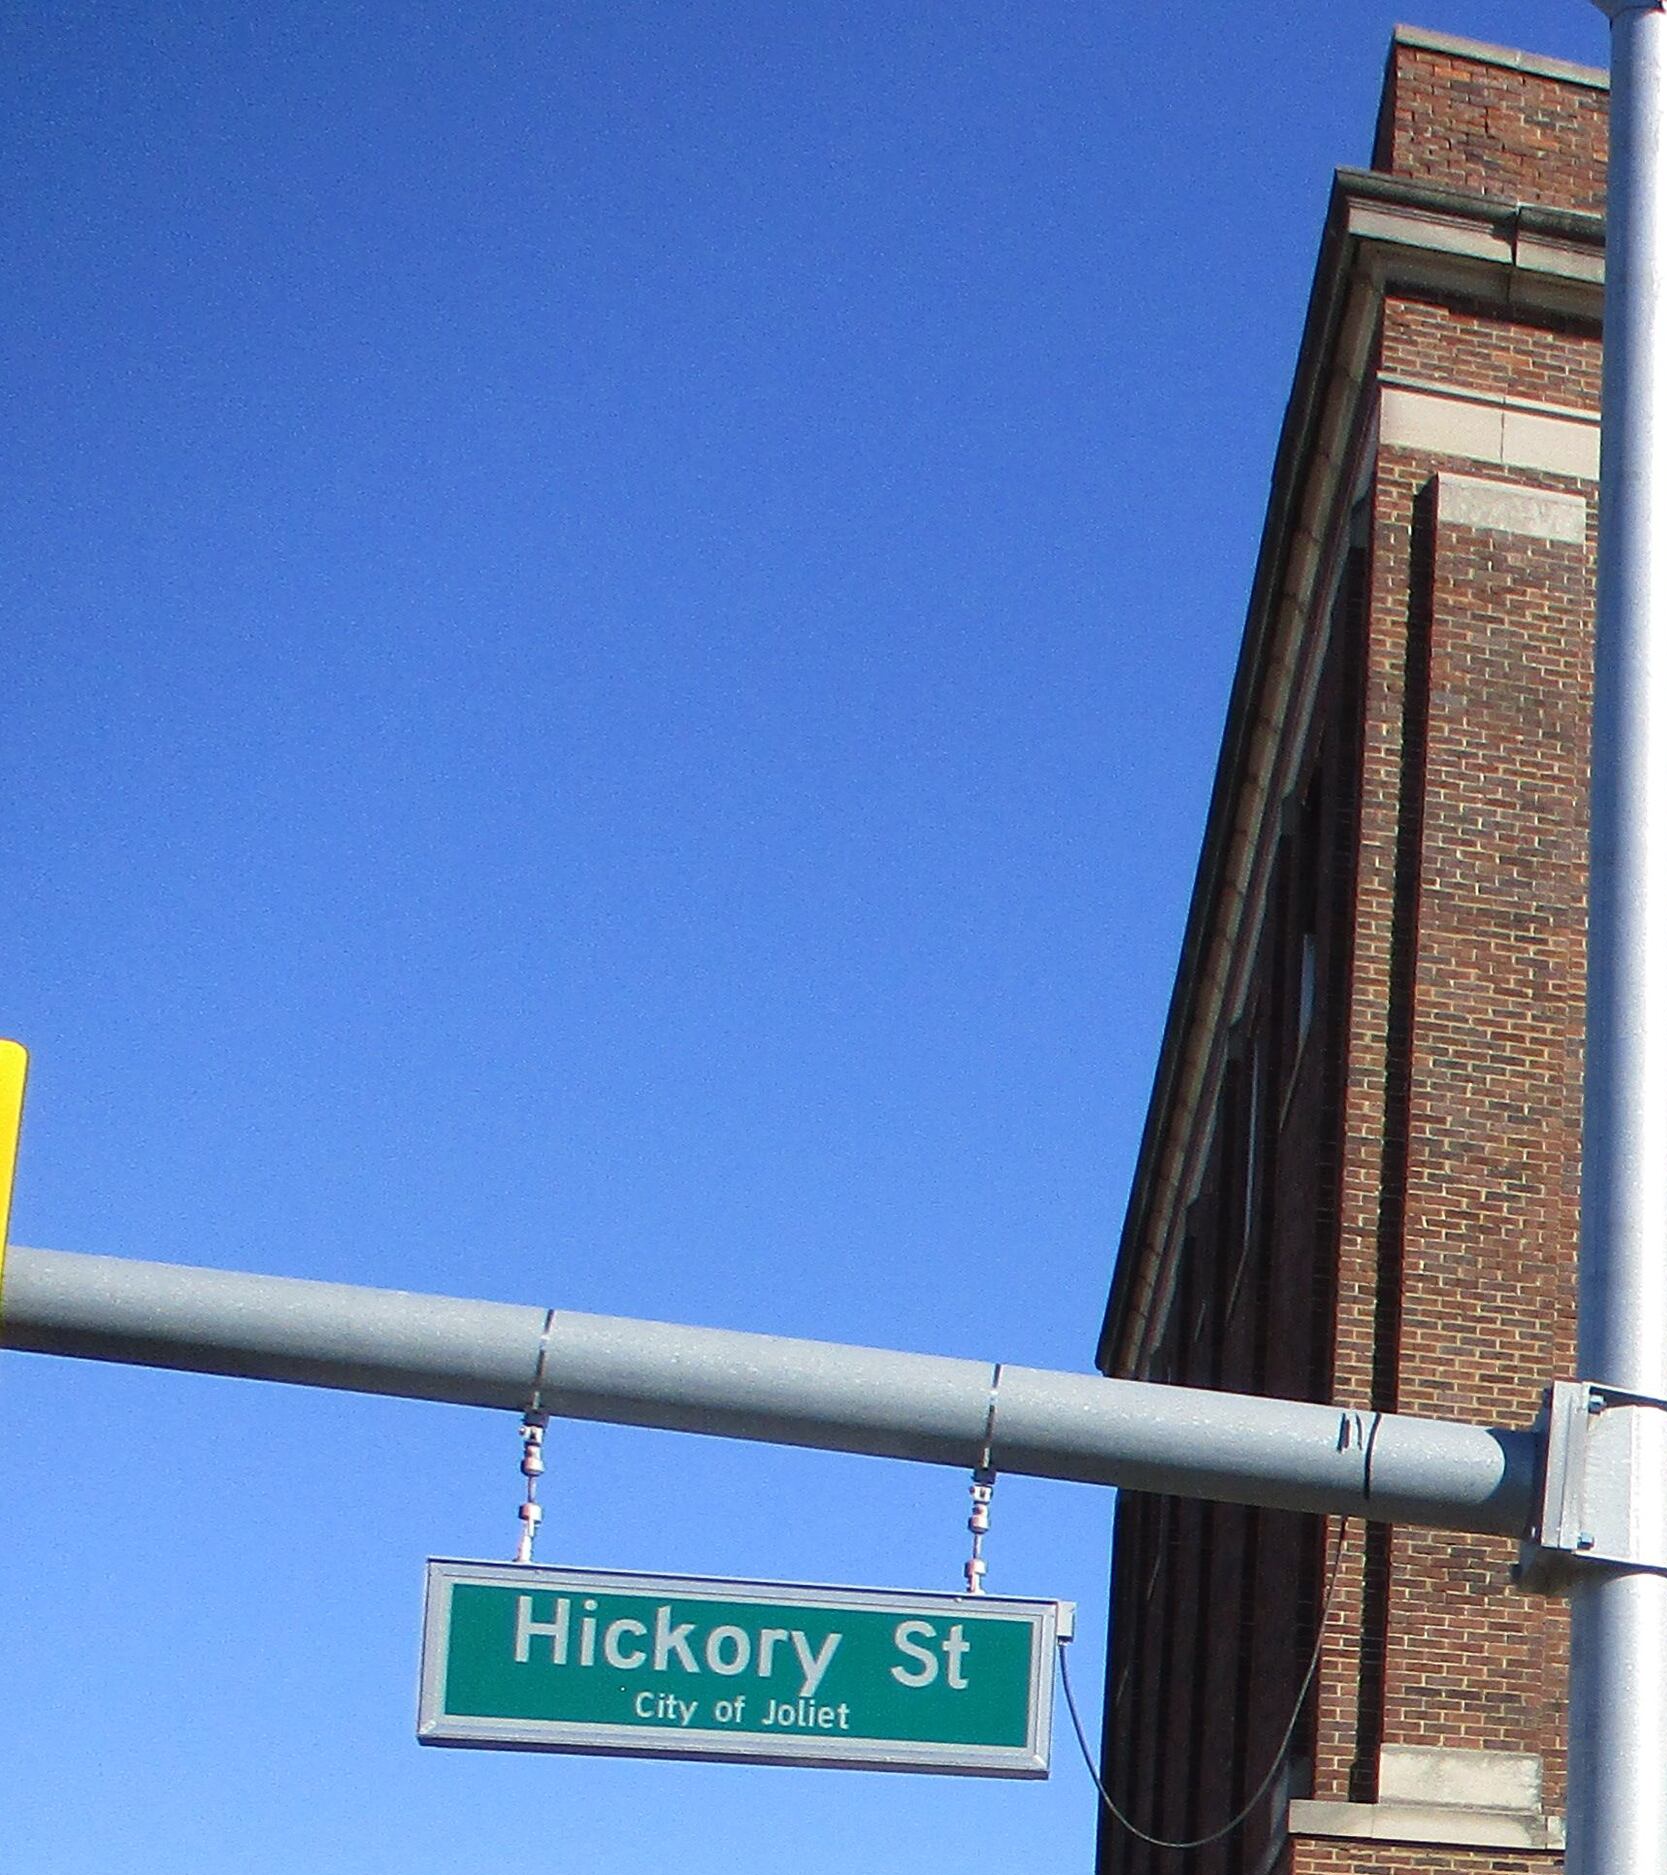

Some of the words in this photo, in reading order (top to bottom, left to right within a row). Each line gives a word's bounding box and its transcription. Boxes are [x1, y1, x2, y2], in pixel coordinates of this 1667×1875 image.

[513, 1595, 843, 1698] Hickory
[890, 1620, 972, 1690] St
[633, 1690, 699, 1728] City
[715, 1695, 747, 1724] of
[761, 1697, 851, 1731] Joliet
